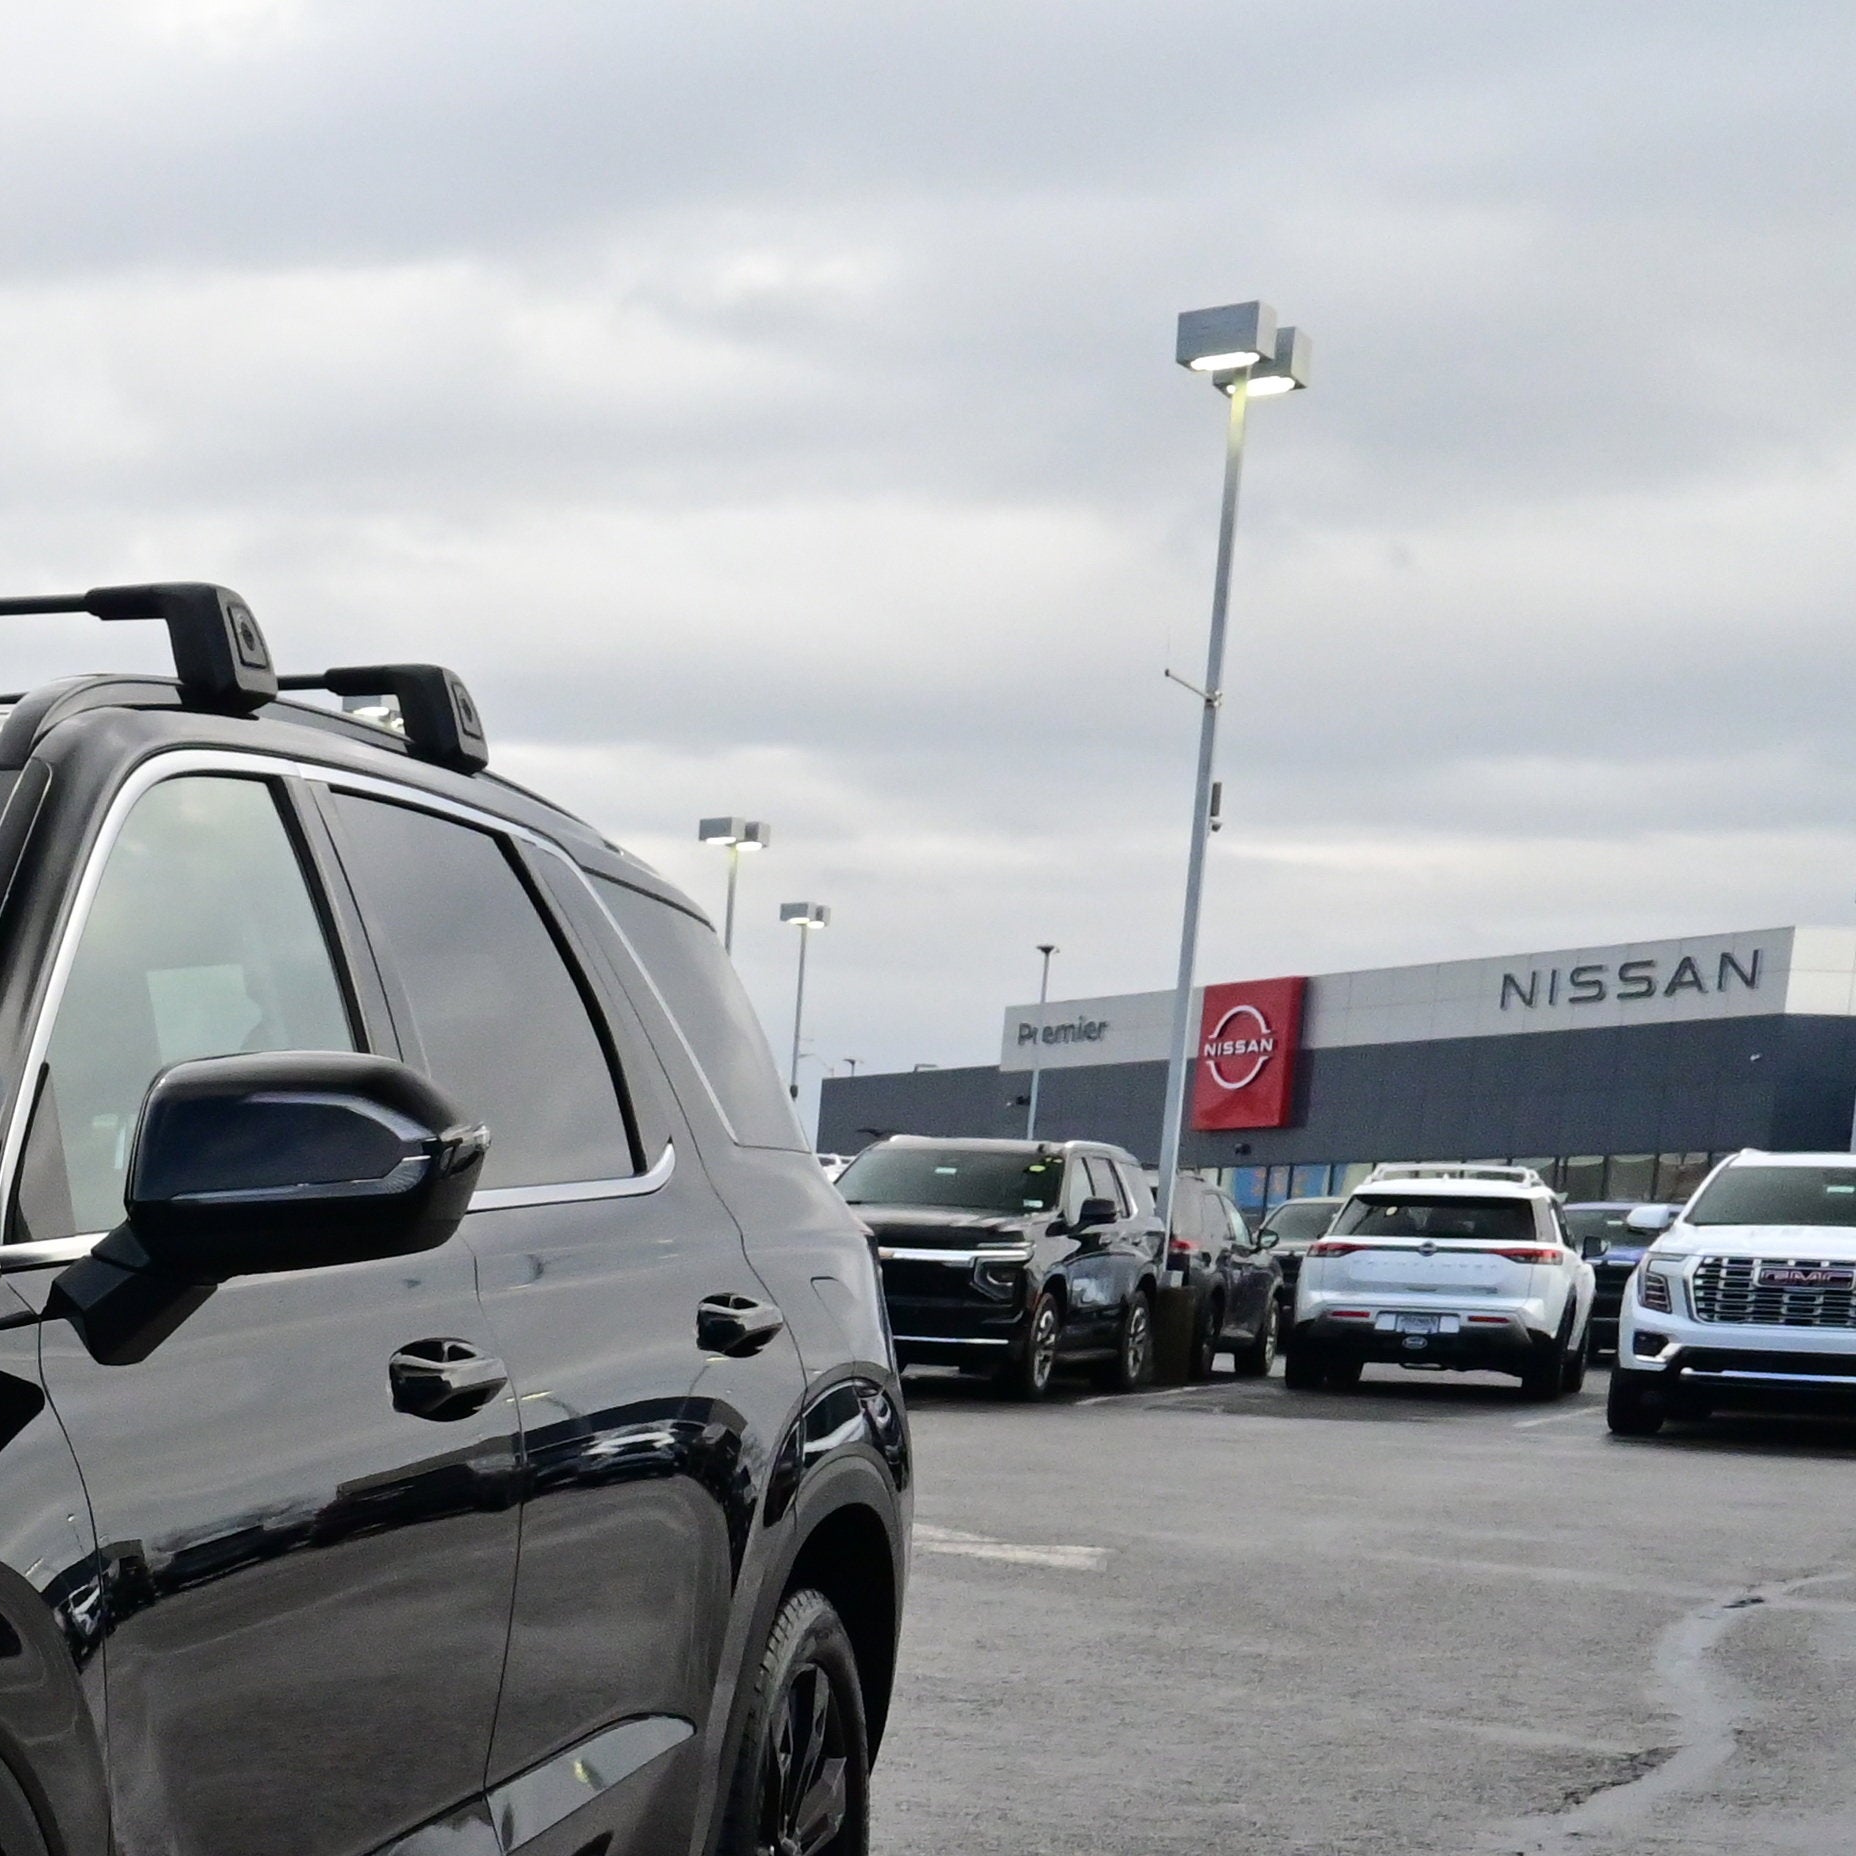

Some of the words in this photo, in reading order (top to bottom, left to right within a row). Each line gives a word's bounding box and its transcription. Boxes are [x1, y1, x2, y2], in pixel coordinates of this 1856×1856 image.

[1499, 949, 1761, 1011] NISSAN
[1203, 1037, 1274, 1057] NISSAN
[1760, 1269, 1853, 1287] GMC
